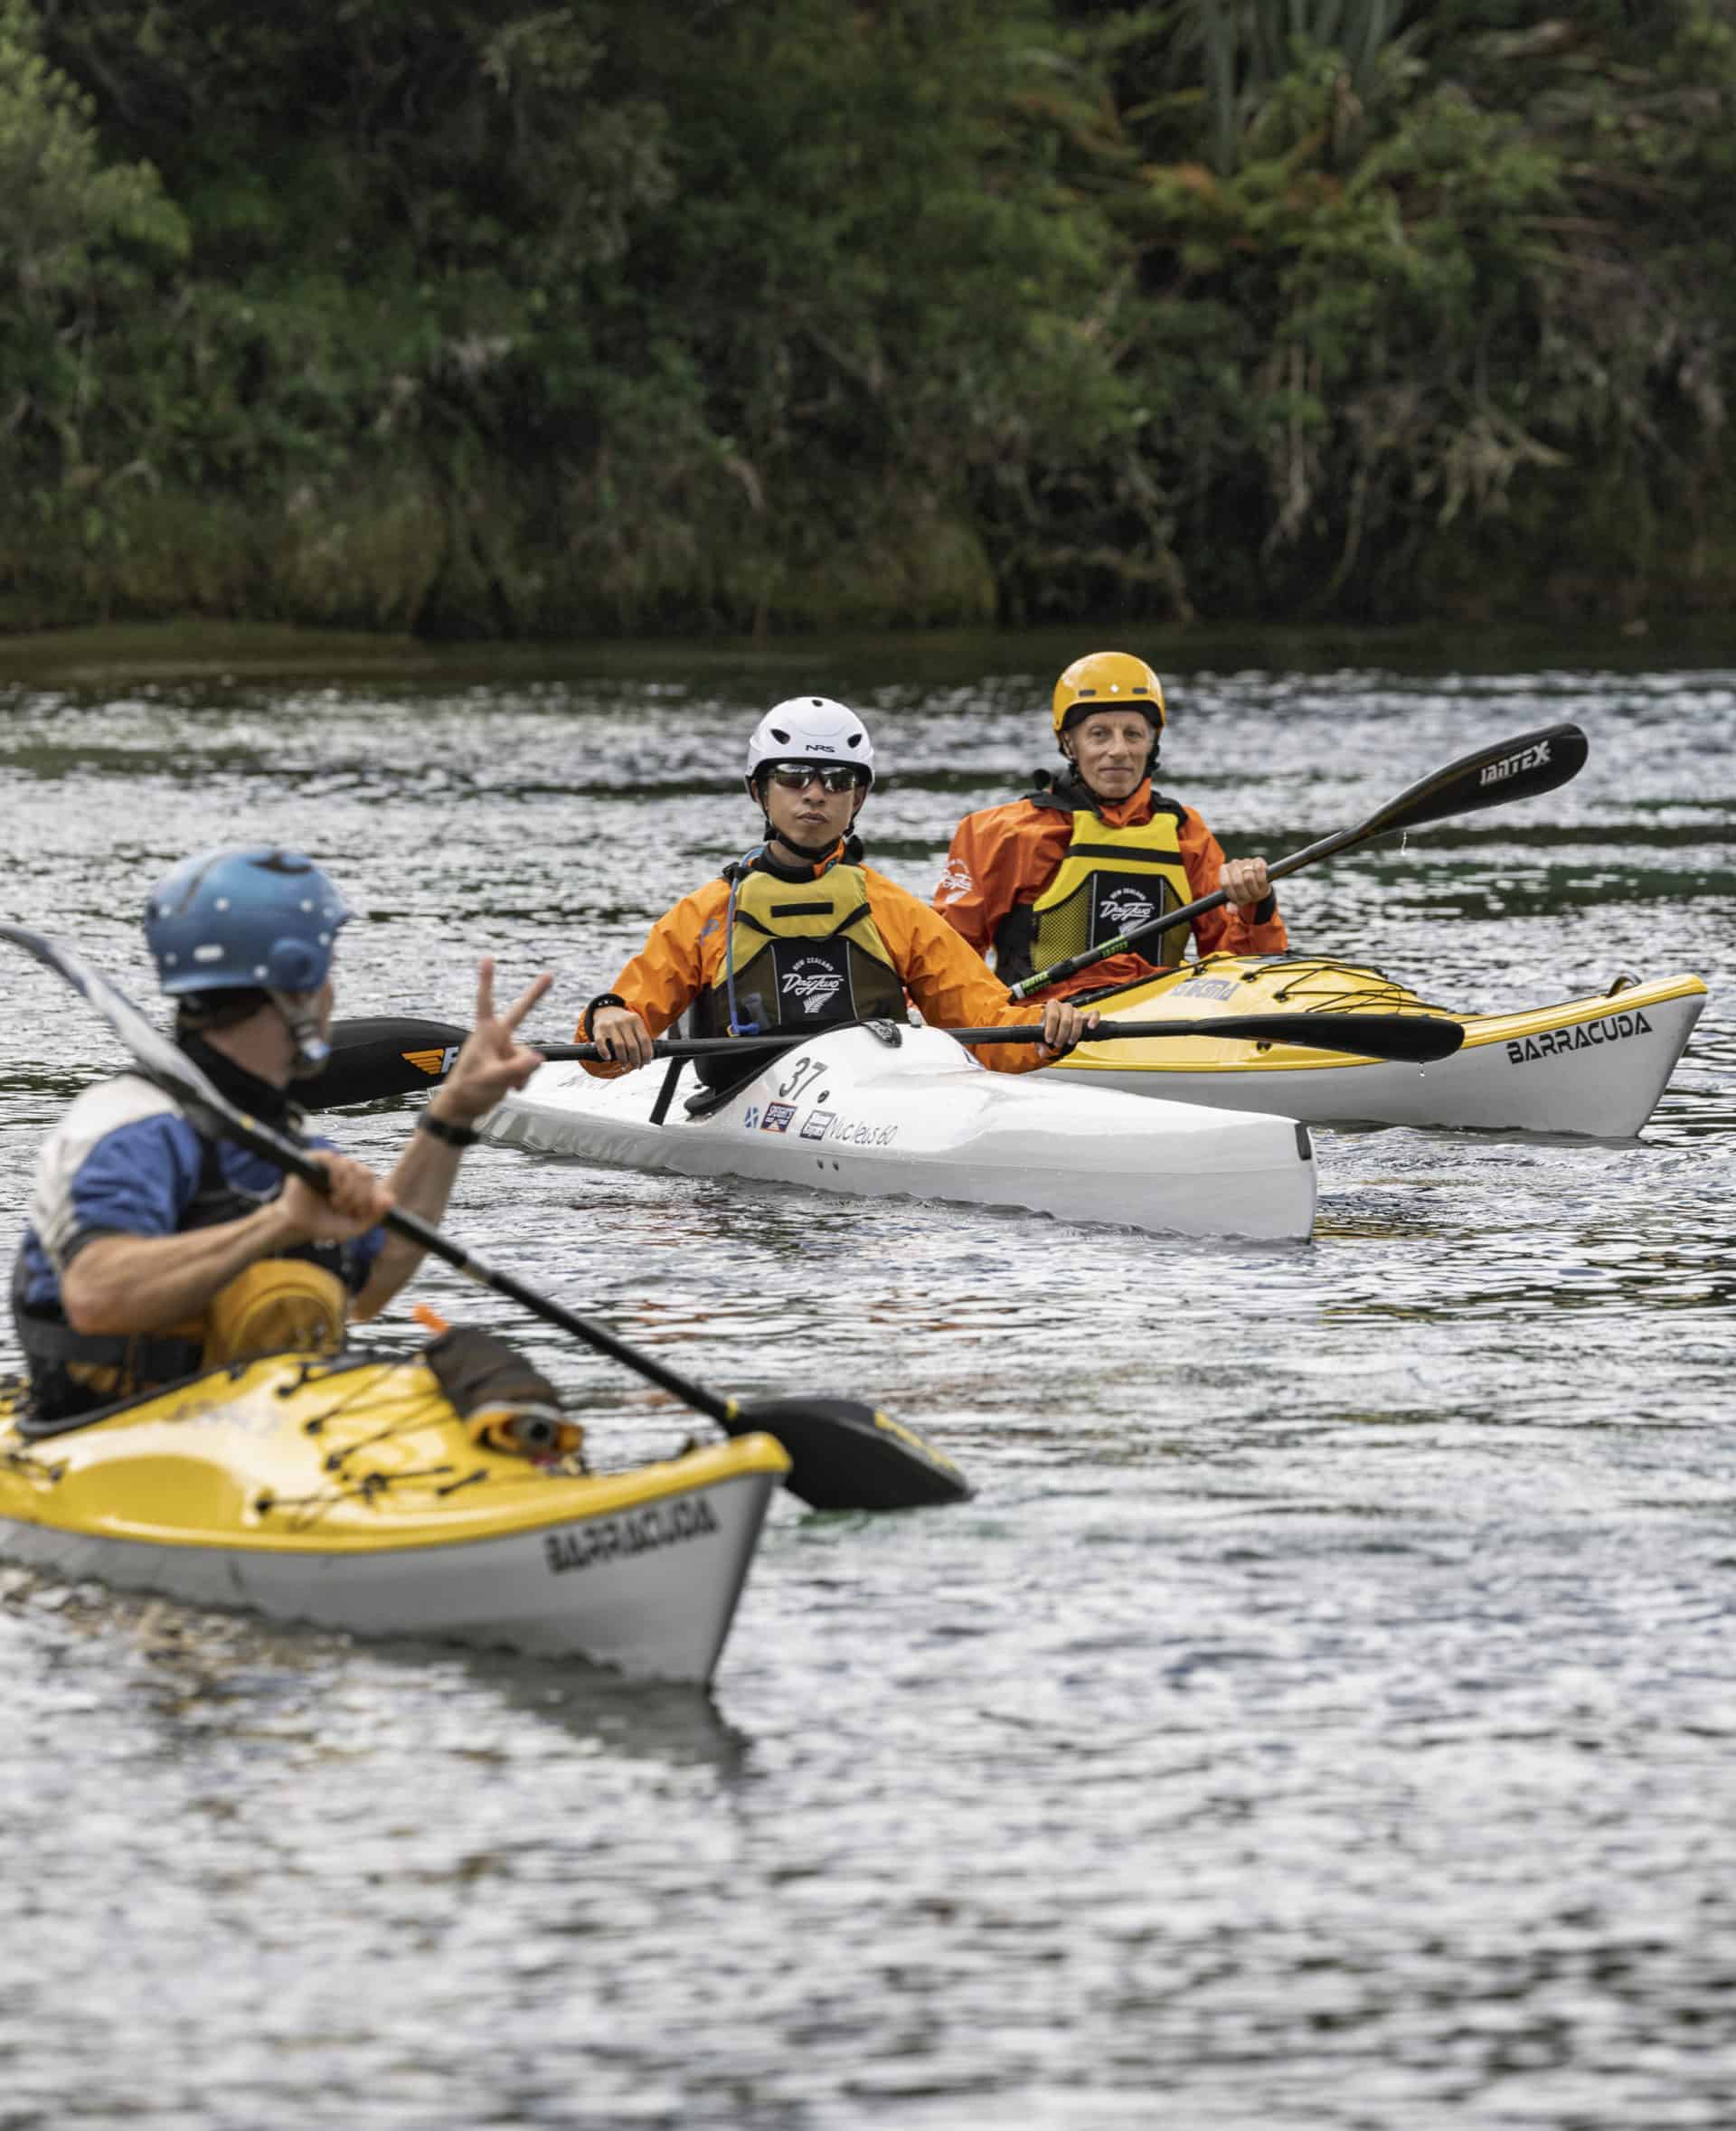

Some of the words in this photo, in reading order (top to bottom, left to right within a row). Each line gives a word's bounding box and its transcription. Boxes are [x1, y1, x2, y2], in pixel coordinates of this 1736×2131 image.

[806, 744, 835, 752] NRS
[792, 959, 805, 971] NEW
[807, 957, 834, 971] ZEALAND
[1506, 1011, 1654, 1065] BARRACUDA
[779, 1057, 829, 1100] 37
[543, 1496, 720, 1576] BARRACUDA
